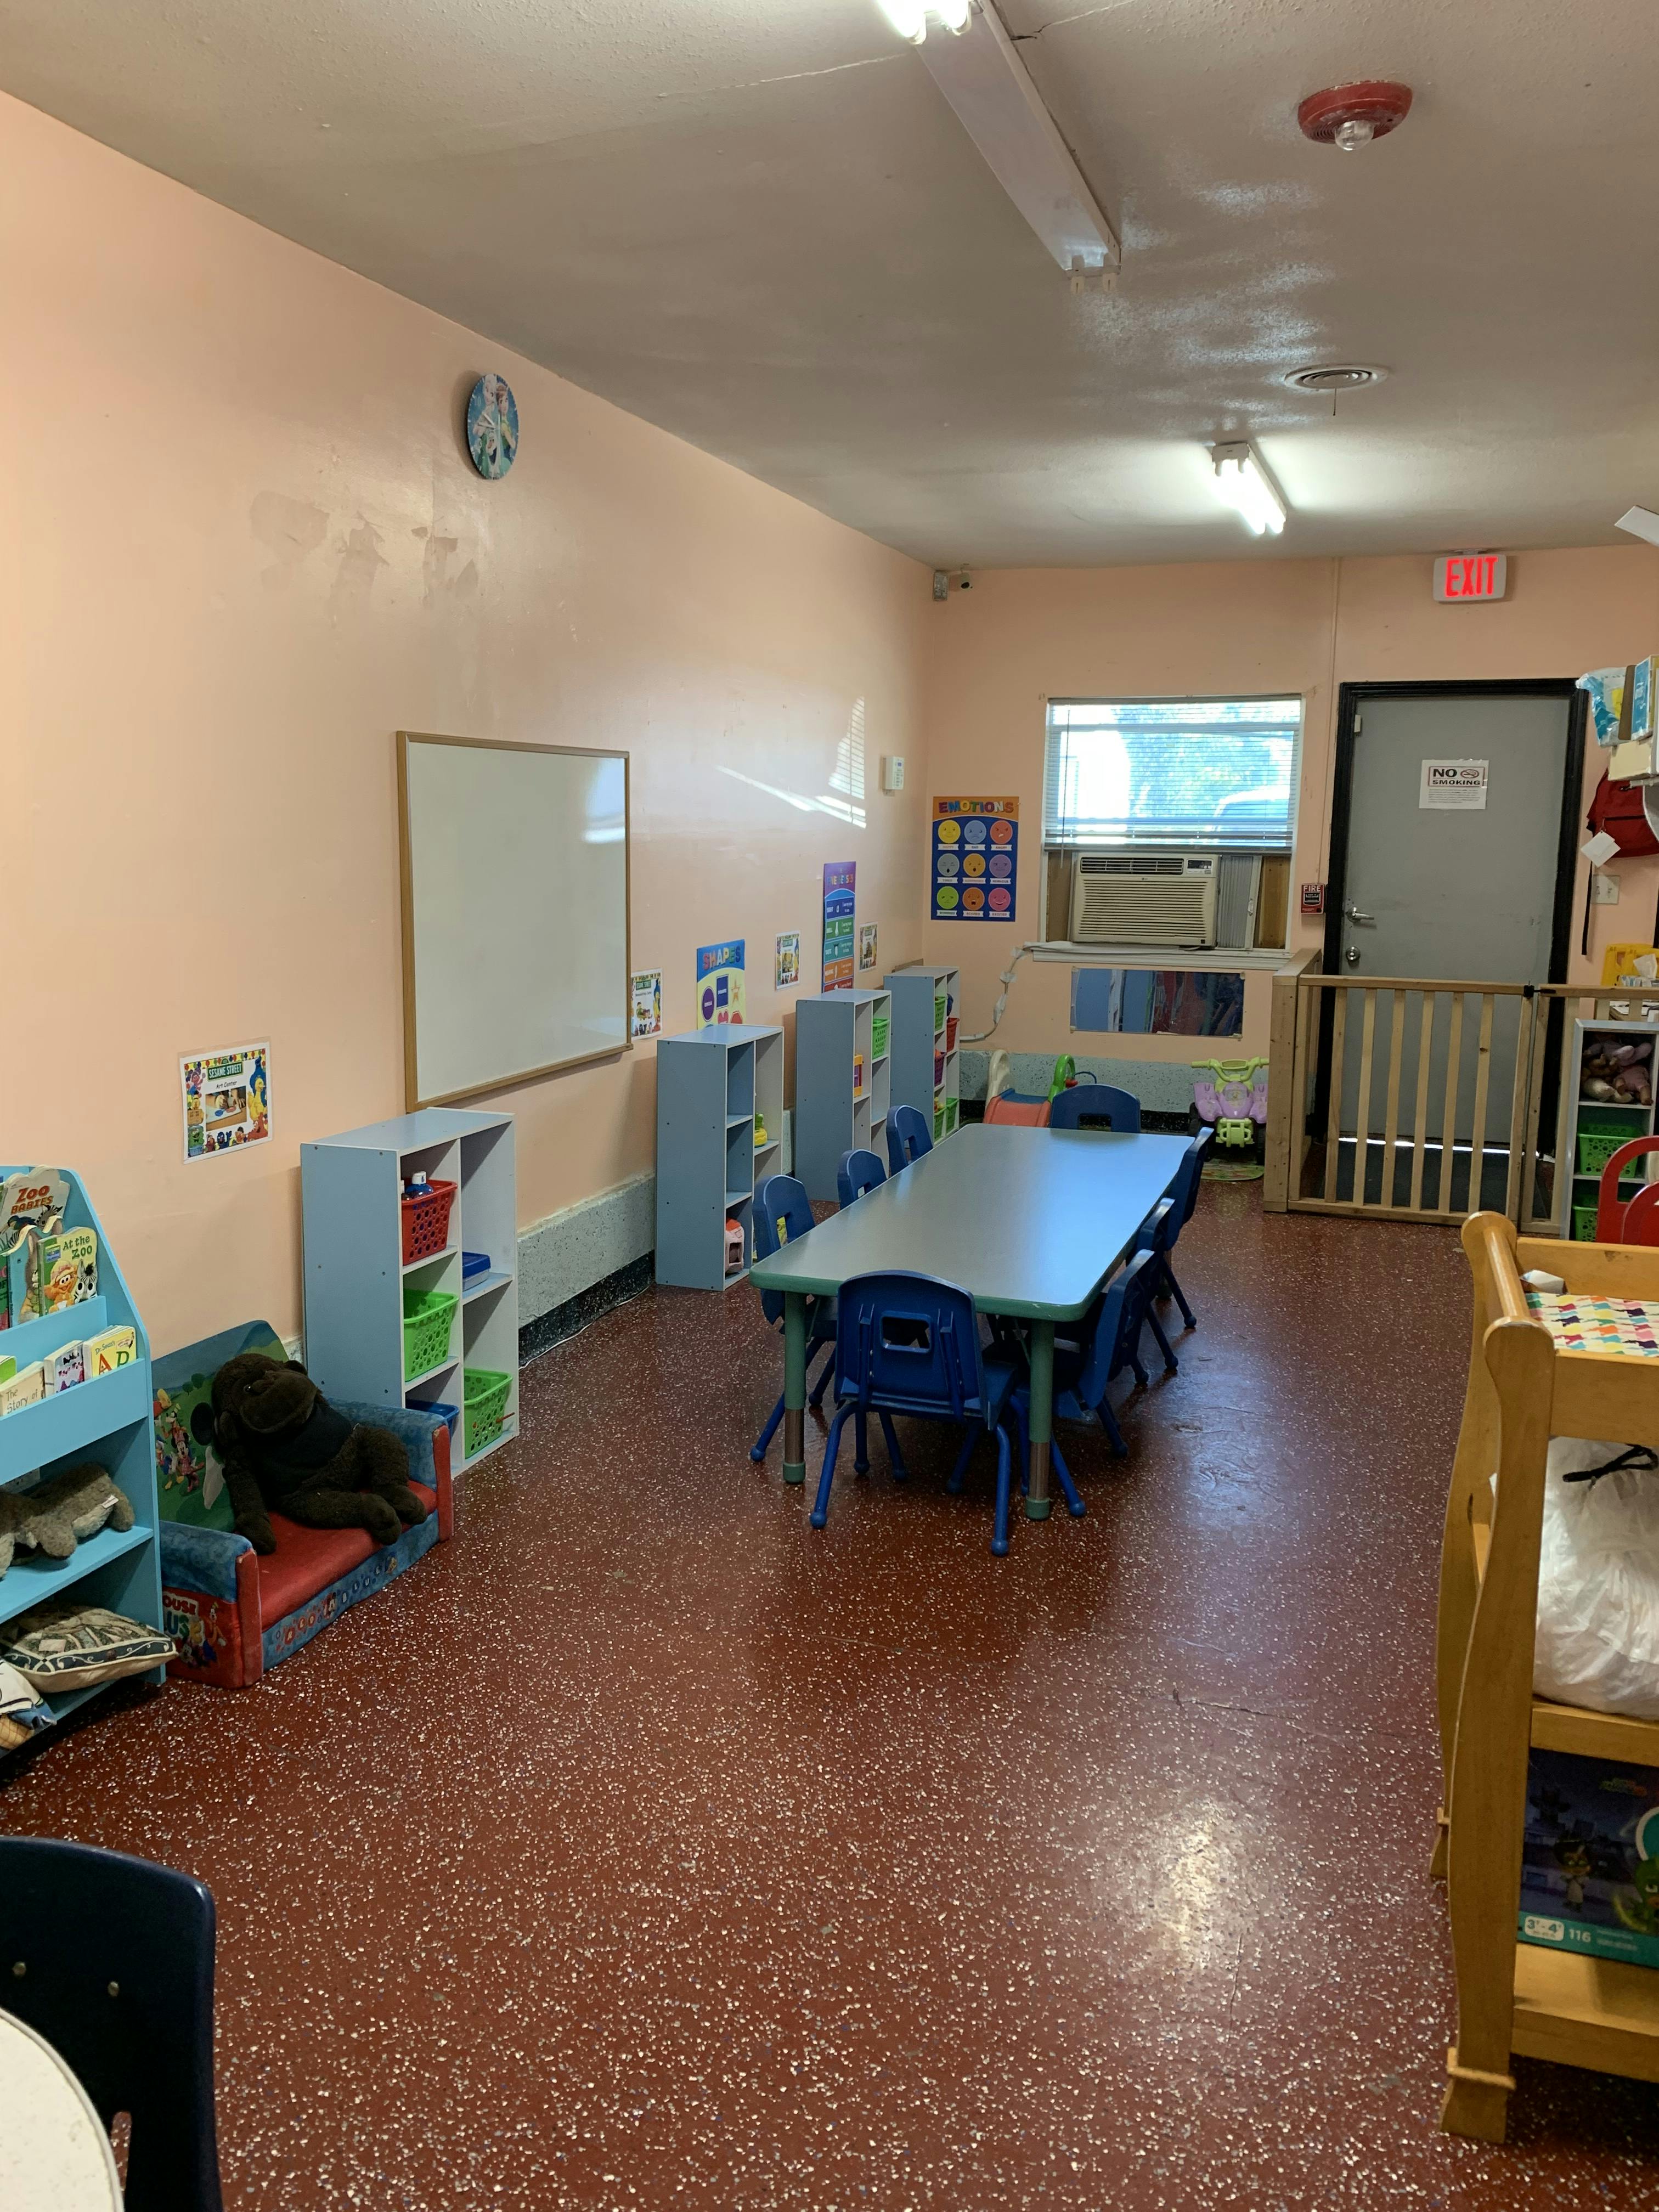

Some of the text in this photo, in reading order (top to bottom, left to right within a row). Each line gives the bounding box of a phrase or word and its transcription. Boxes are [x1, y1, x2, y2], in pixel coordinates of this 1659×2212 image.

[1445, 556, 1498, 597] EXIT
[1433, 769, 1457, 777] NO
[939, 800, 1014, 813] EMOTIONS
[703, 946, 741, 970] SHAPES
[208, 1063, 241, 1079] SESAME STREET
[10, 1195, 54, 1215] BABIES
[63, 1235, 90, 1250] At the
[6, 1389, 18, 1401] The
[7, 1396, 29, 1414] Story
[162, 1594, 196, 1616] OUSE
[1568, 1928, 1591, 1943] 116
